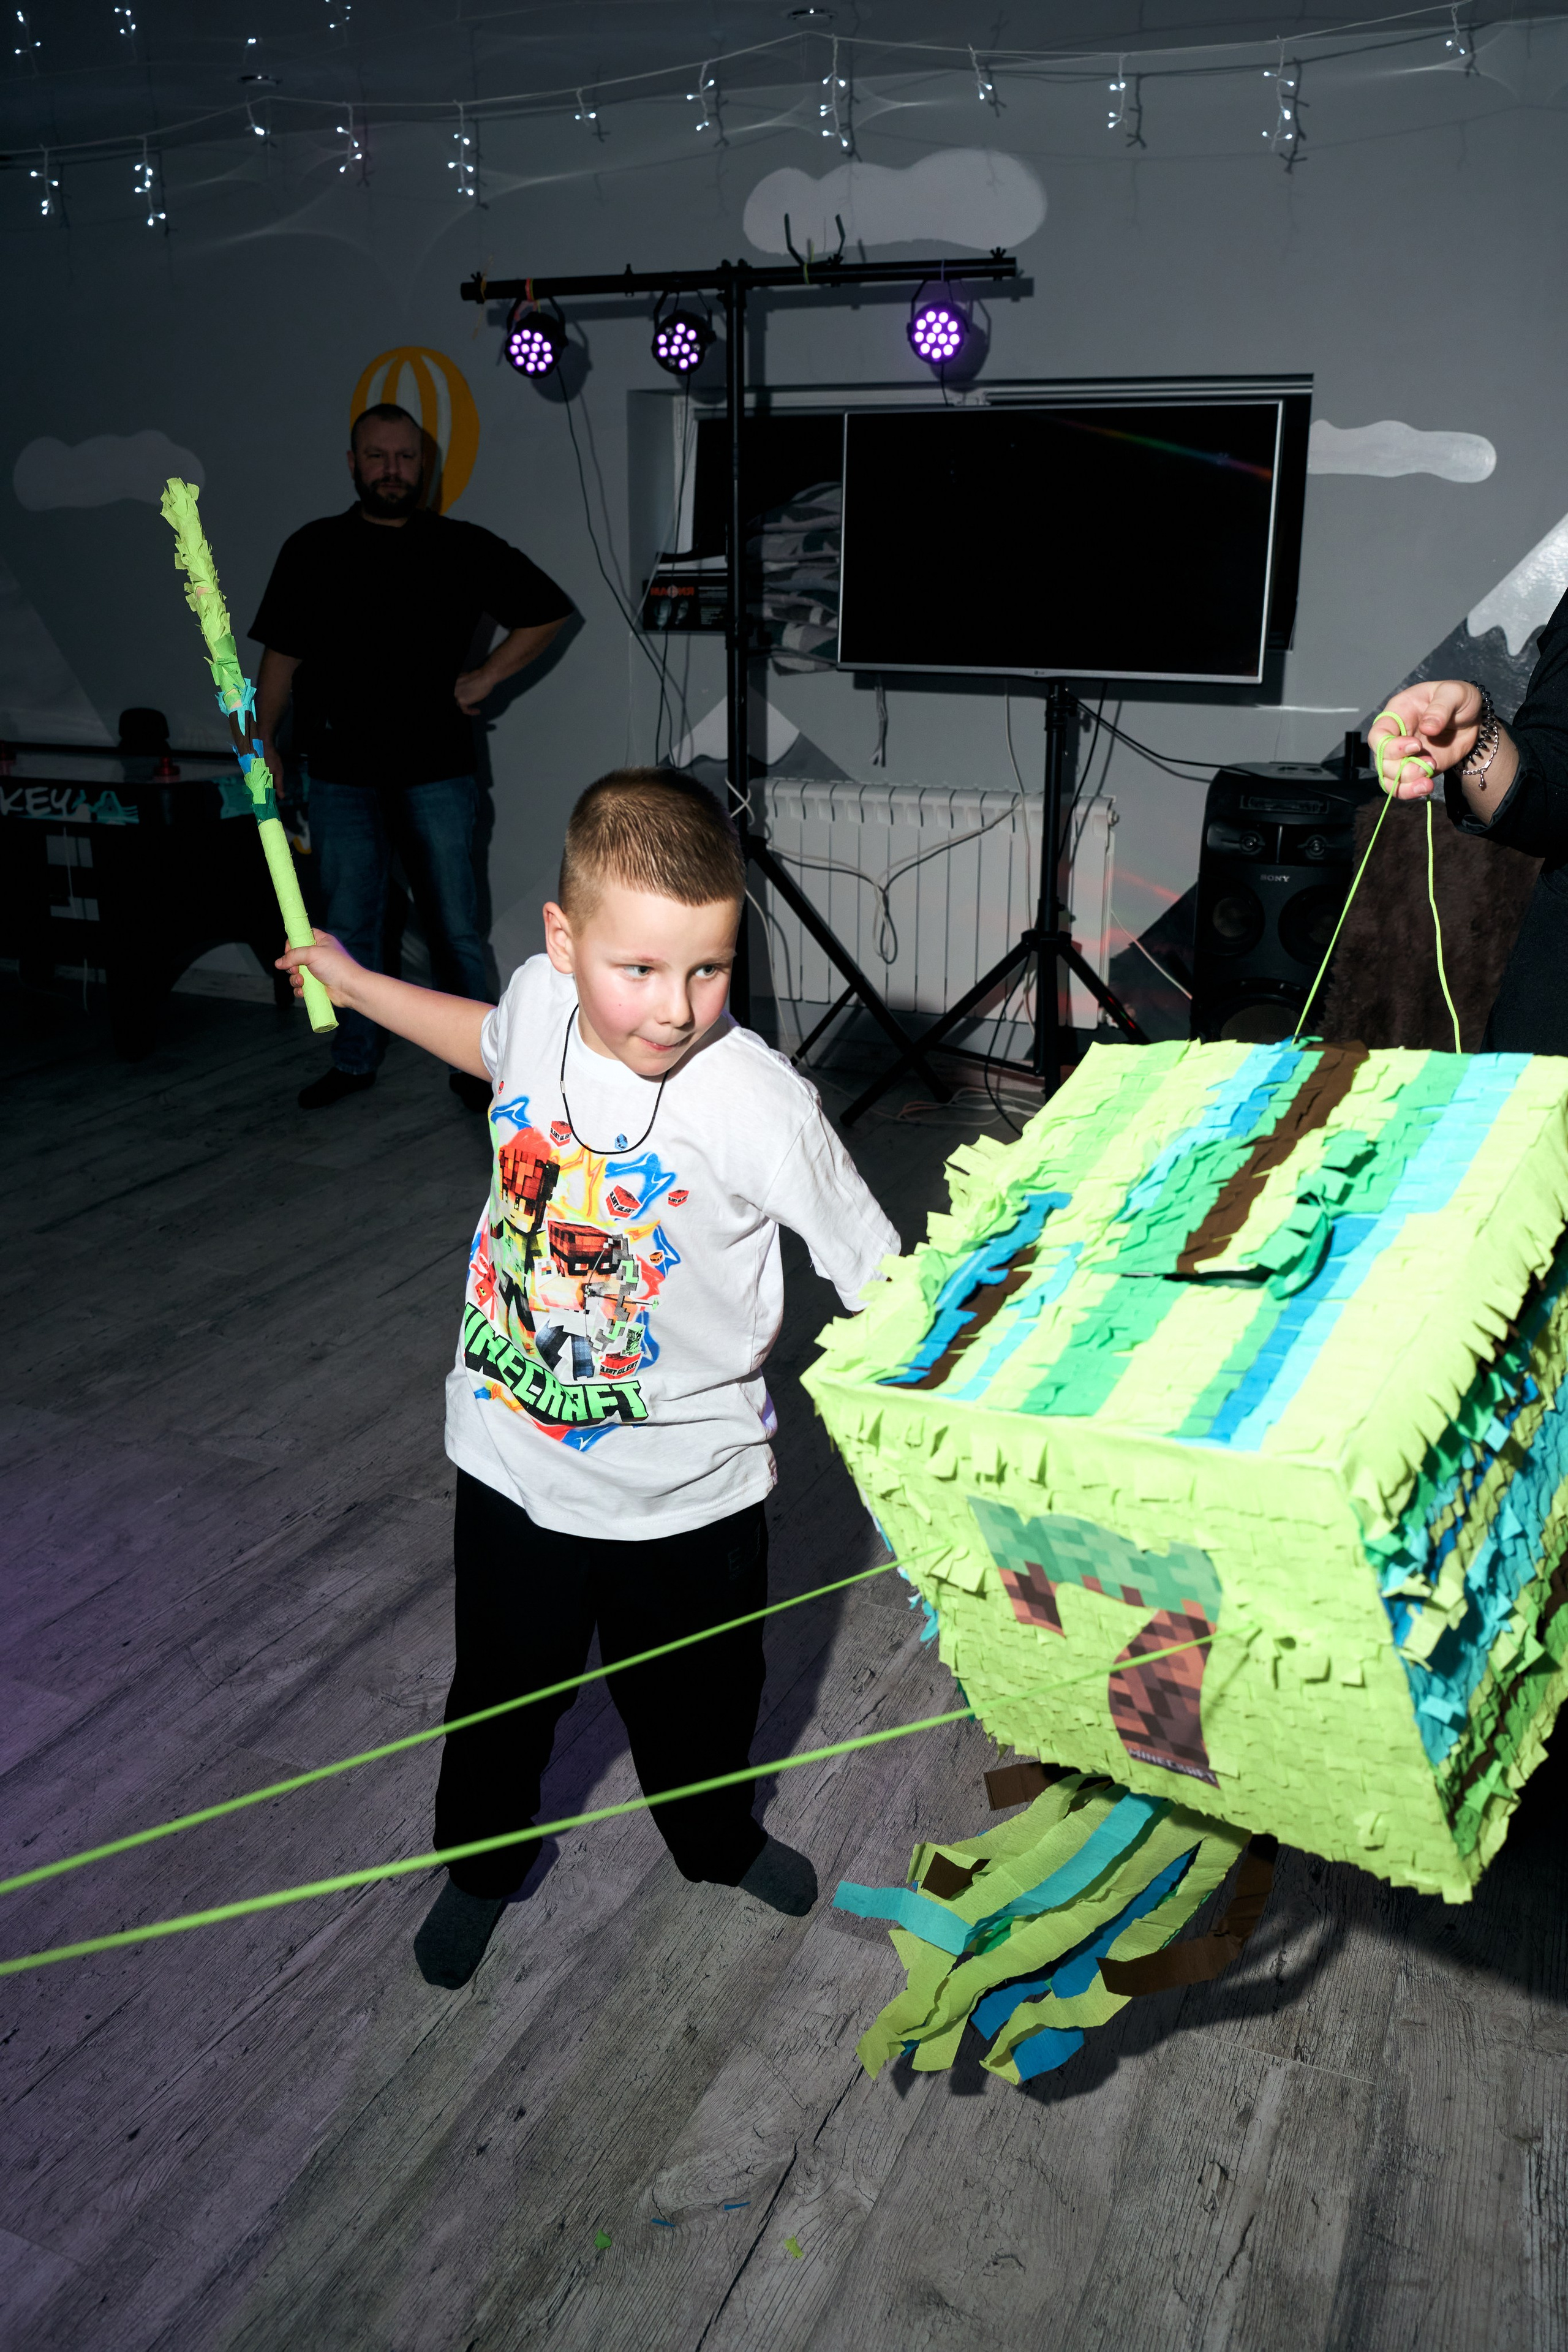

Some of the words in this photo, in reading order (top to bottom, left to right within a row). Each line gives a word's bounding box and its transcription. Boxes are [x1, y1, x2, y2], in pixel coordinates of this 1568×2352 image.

[1259, 873, 1290, 883] SONY
[616, 1360, 638, 1375] ALERT
[1128, 1747, 1216, 1783] MINECRAFT
